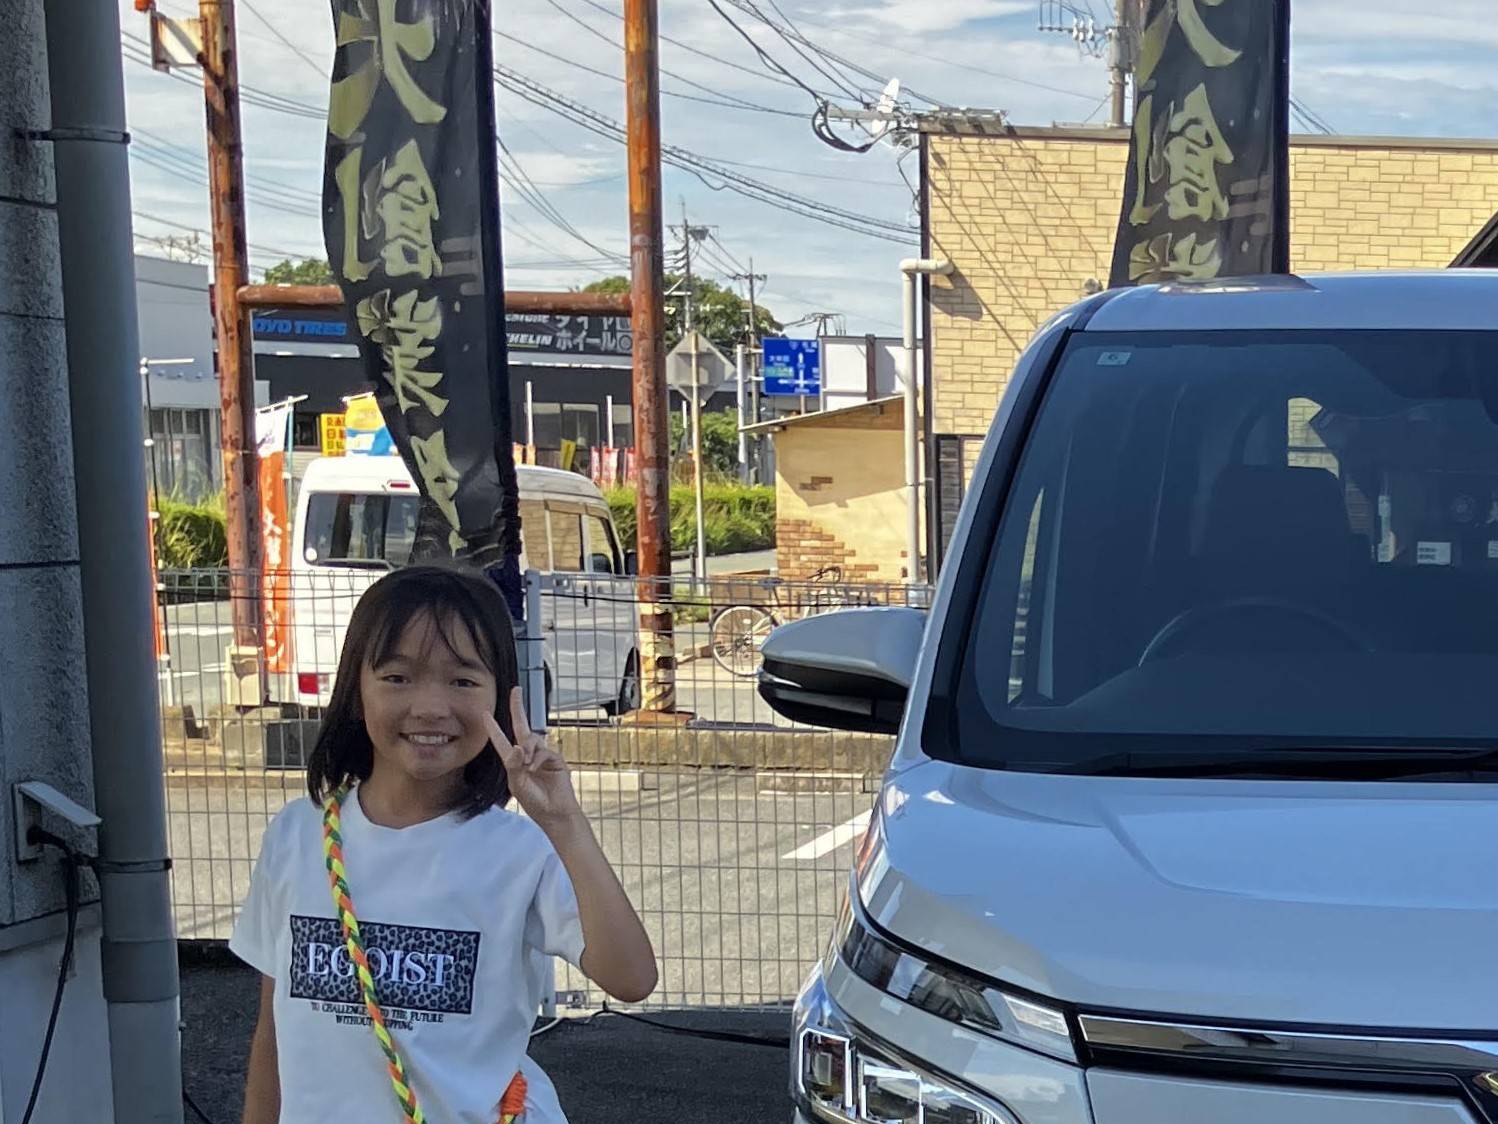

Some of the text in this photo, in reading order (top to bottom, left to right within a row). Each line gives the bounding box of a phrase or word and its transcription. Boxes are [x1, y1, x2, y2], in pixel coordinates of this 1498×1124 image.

[253, 318, 292, 334] OYO
[306, 942, 454, 988] EGOIST
[410, 1011, 444, 1023] FUTURE
